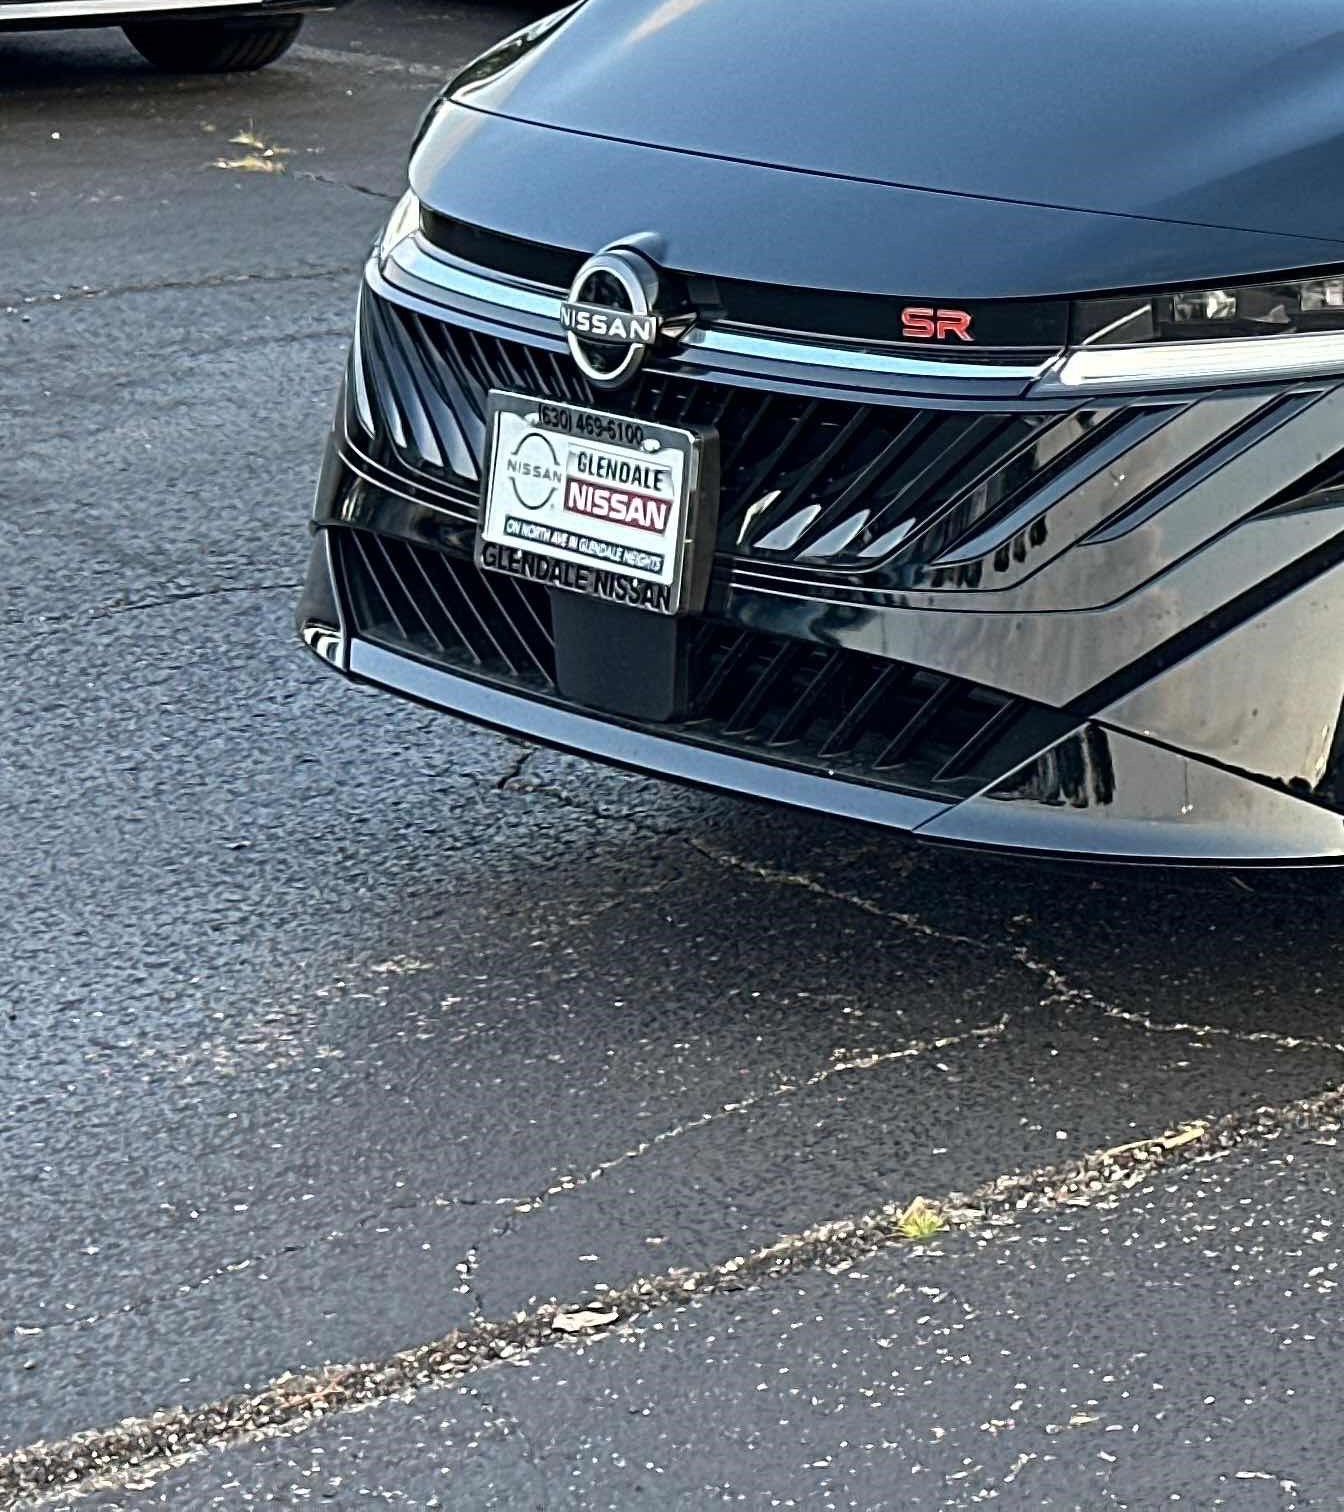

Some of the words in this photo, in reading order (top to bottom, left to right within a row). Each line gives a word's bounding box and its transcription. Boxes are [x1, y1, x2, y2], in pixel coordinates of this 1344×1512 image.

[560, 302, 654, 341] NISSAN
[901, 306, 976, 342] SR
[537, 402, 572, 433] (630)
[576, 412, 644, 446] 469-6100
[506, 458, 562, 484] NISSAN
[576, 450, 665, 493] GLENDALE
[567, 481, 667, 532] NISSAN
[506, 519, 521, 535] ON
[521, 522, 551, 543] NORTH
[568, 535, 579, 550] IN
[578, 538, 624, 563] GLENDALE
[482, 542, 590, 589] GLENDALE
[593, 570, 671, 611] NISSAN
